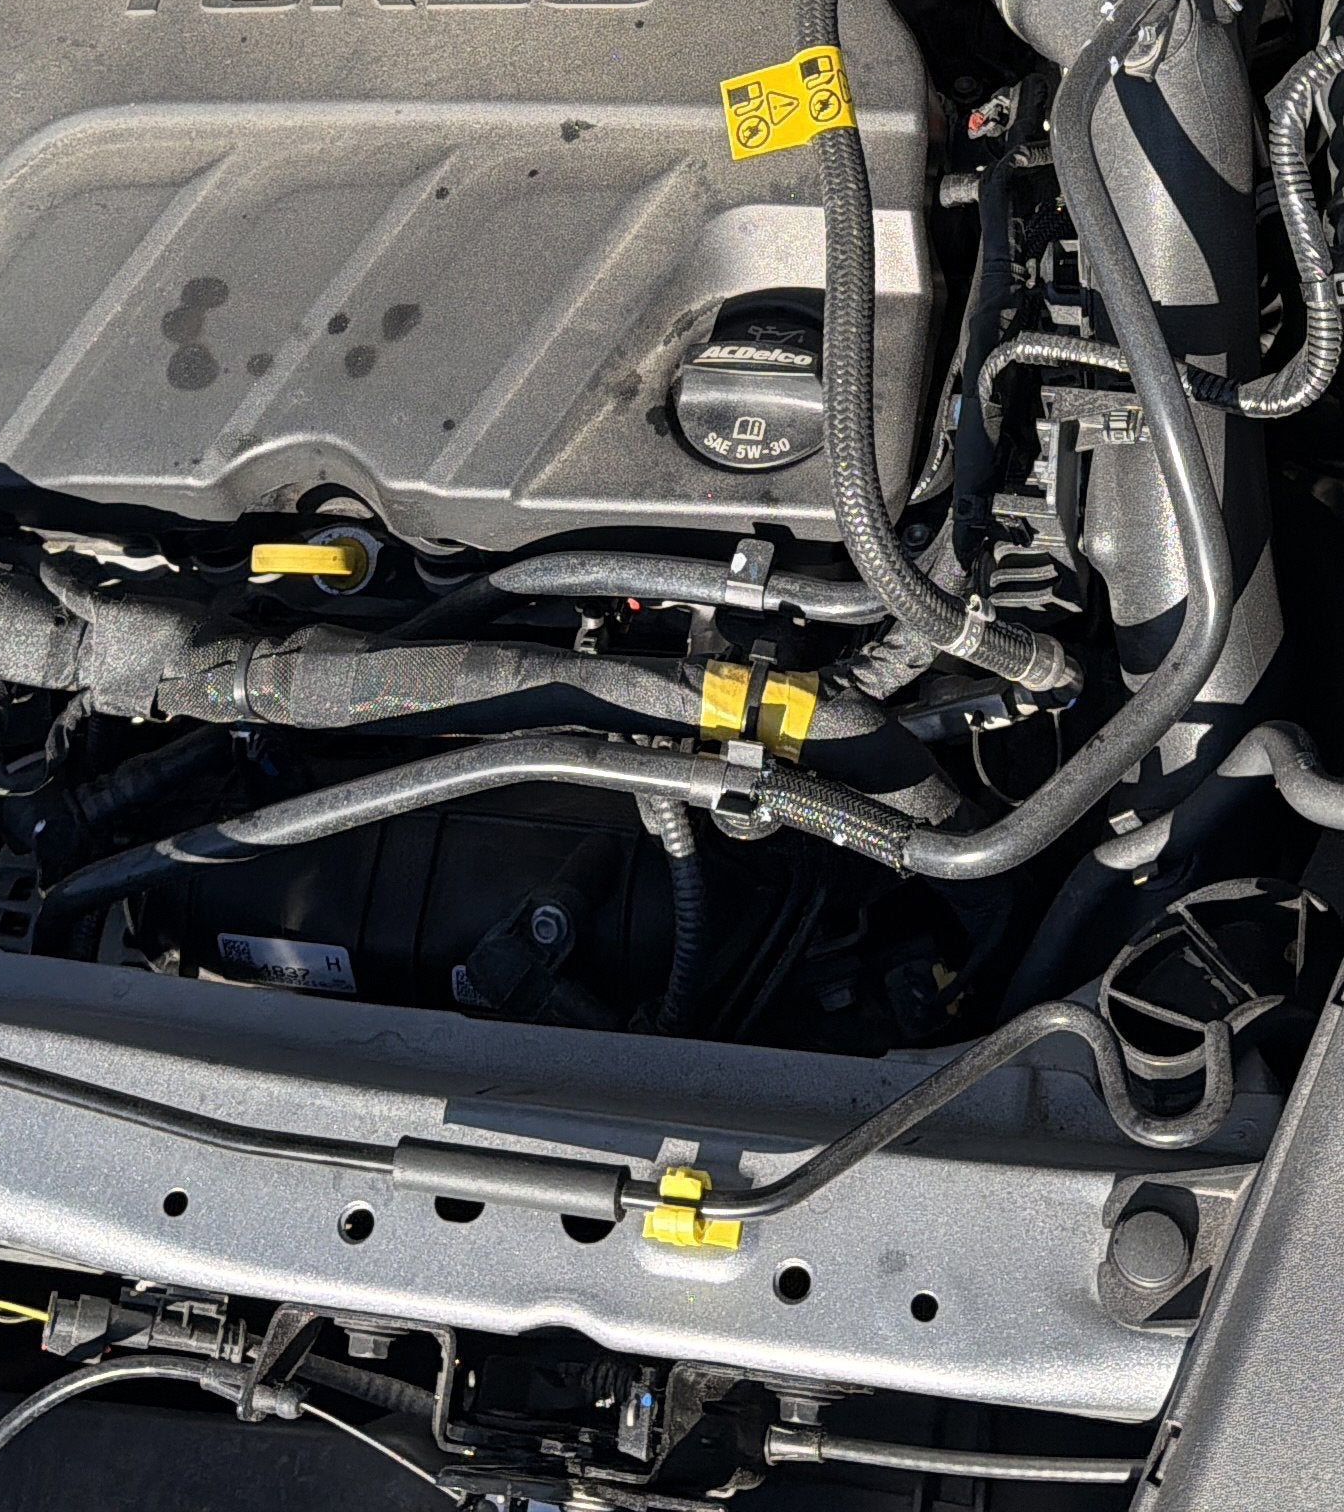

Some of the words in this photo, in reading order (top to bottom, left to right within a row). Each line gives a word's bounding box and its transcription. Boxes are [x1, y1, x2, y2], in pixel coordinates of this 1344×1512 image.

[699, 345, 813, 366] ACDelco
[703, 432, 732, 456] SAE
[736, 438, 791, 460] 5W-30
[326, 956, 342, 972] H
